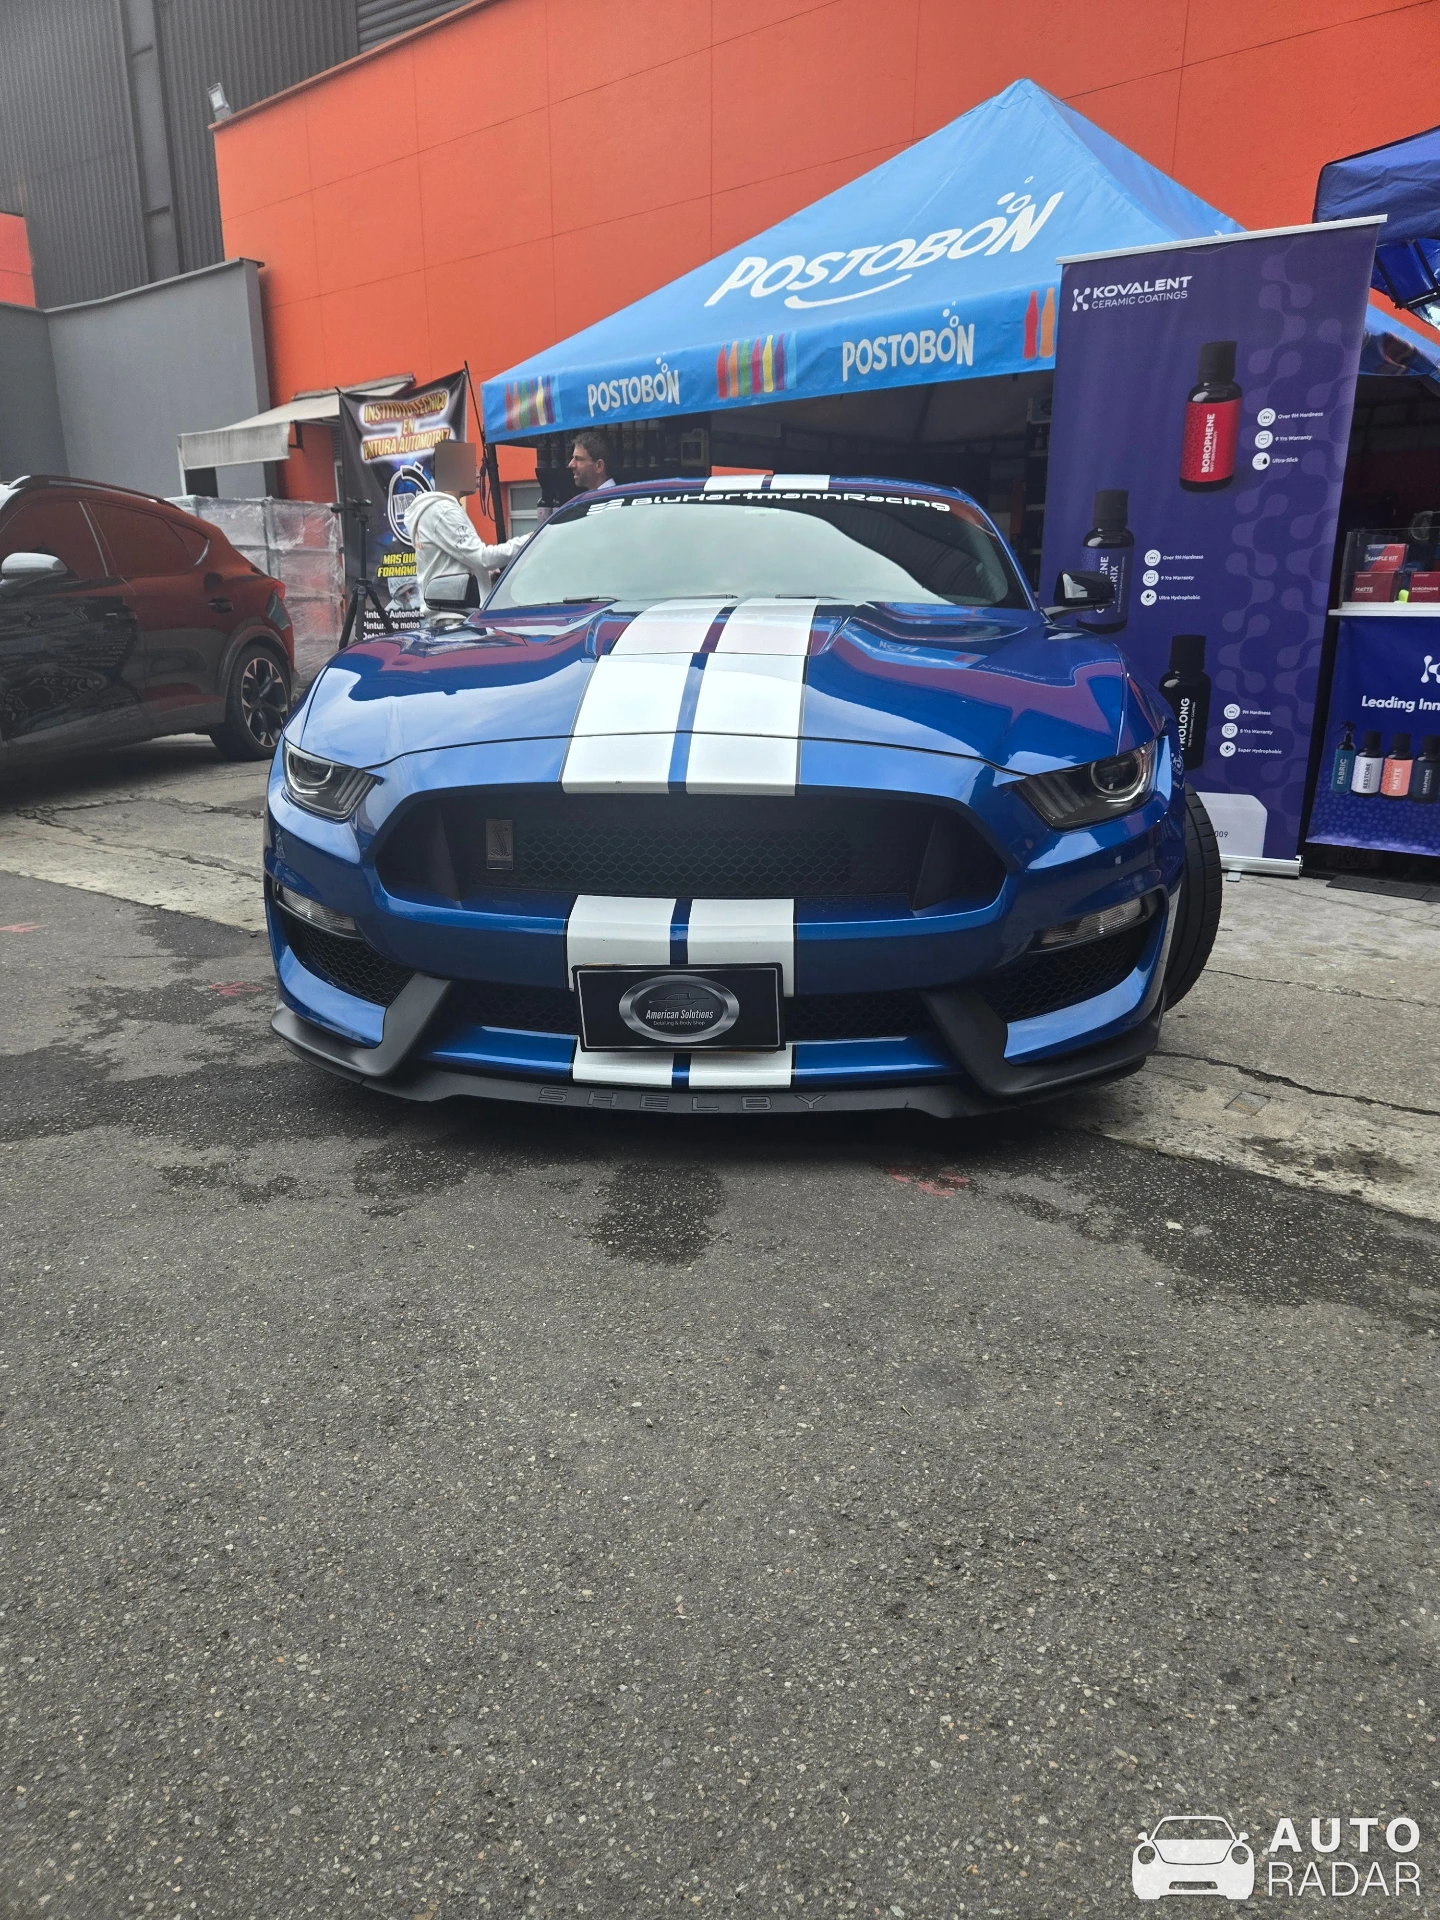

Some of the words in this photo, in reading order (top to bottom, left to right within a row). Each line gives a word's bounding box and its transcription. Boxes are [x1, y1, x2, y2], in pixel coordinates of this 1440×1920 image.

[1092, 275, 1193, 299] KOVALENT
[1091, 296, 1136, 310] CERAMIC
[1137, 290, 1188, 304] COATINGS
[402, 418, 415, 435] EN
[363, 436, 396, 460] INTURA
[1201, 413, 1216, 474] BOROPHENE
[382, 553, 402, 565] MAS
[403, 552, 418, 564] QU
[377, 565, 418, 578] FORMAMO
[1361, 695, 1416, 713] Leading
[1178, 698, 1190, 750] ROLONG
[1337, 758, 1348, 785] FABRIC
[1362, 763, 1372, 789] RESTORE
[1392, 767, 1402, 791] MATTE
[645, 1009, 679, 1020] American
[680, 1009, 714, 1019] Solutions
[538, 1086, 827, 1112] SHELBY
